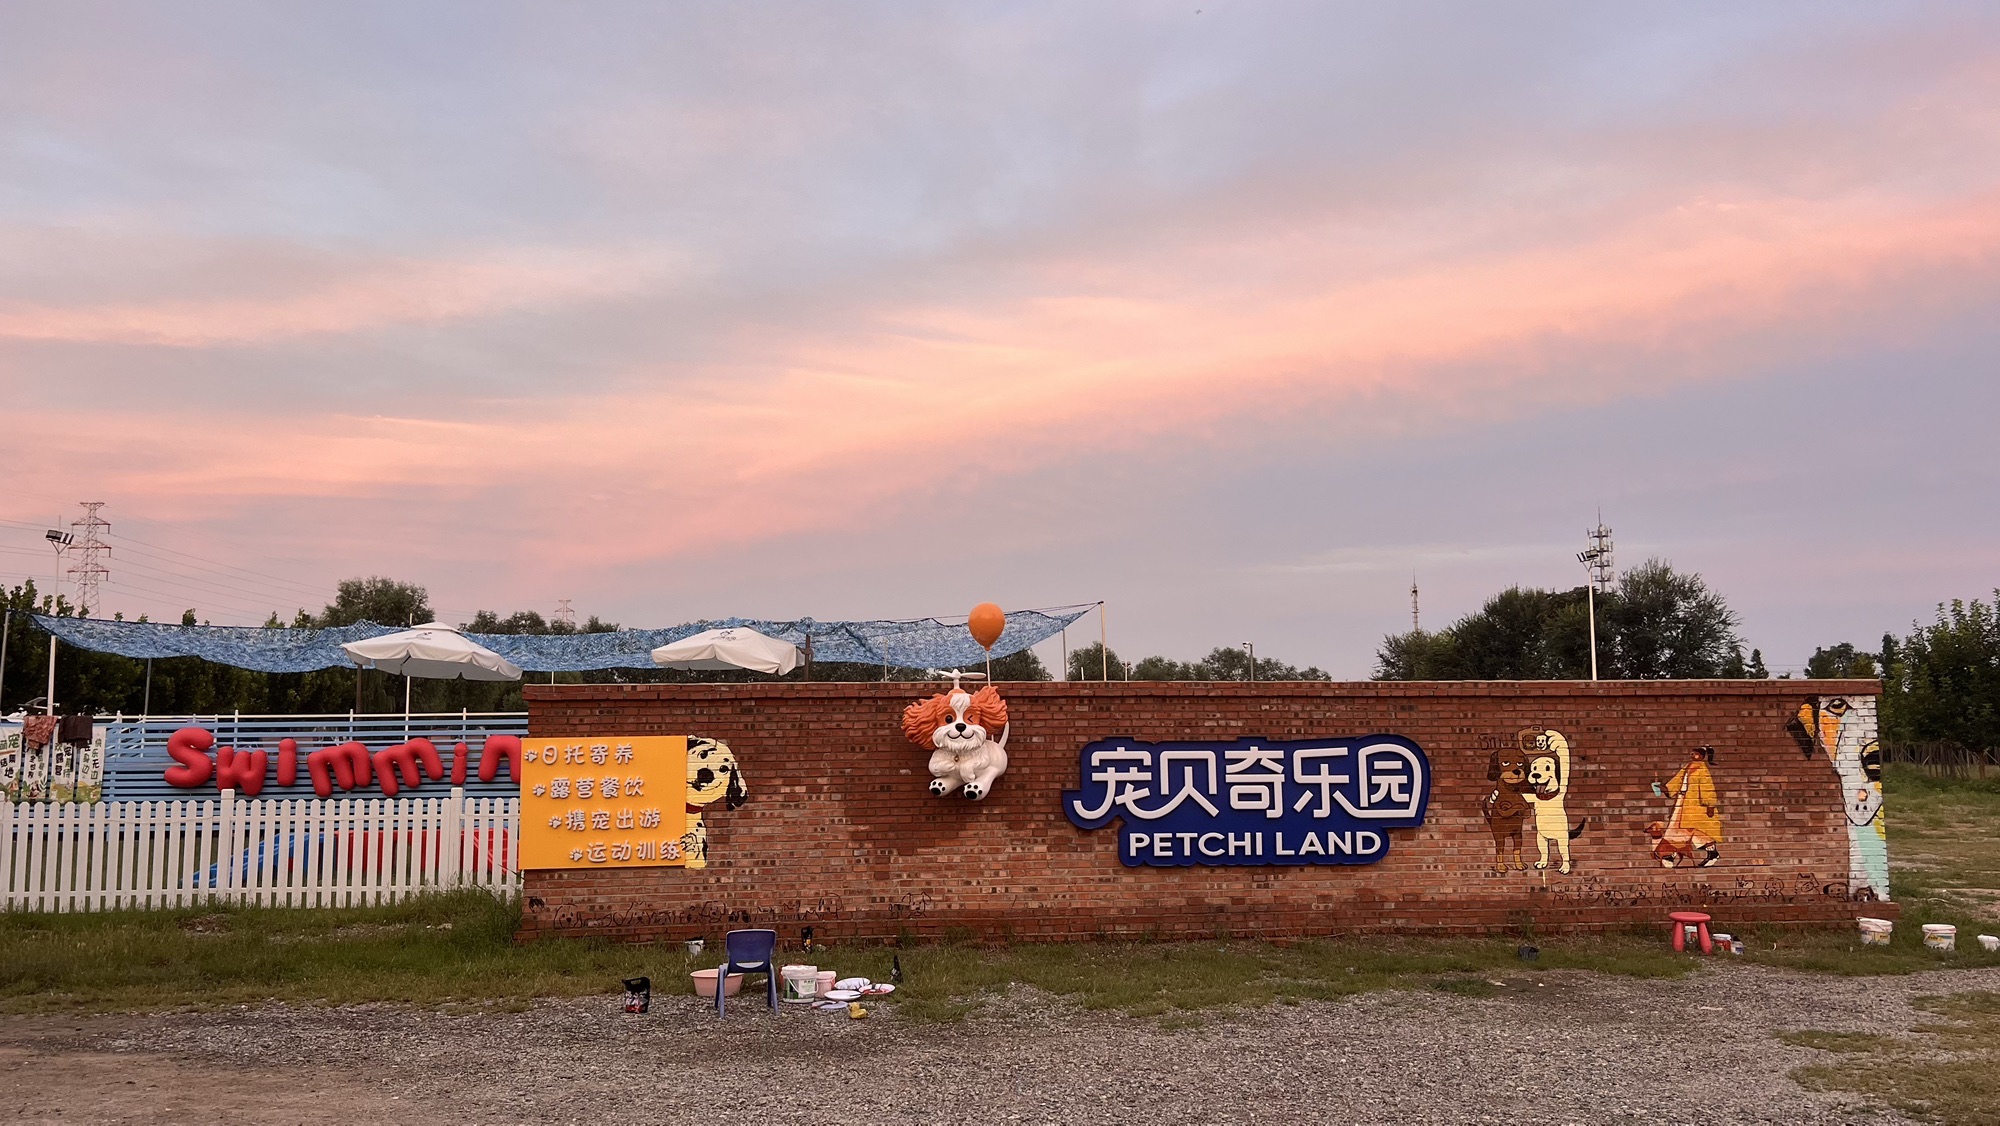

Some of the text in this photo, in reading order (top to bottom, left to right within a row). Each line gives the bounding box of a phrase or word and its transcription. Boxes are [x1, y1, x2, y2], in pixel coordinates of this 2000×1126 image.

[164, 727, 521, 796] Swimmin
[542, 743, 634, 765] 日托寄养
[550, 776, 645, 799] 露营餐饮
[1073, 743, 1423, 819] 宠贝奇乐园
[565, 808, 661, 831] 携宠出游
[586, 840, 682, 863] 运动训练
[1129, 831, 1382, 857] PETCHI LAND
